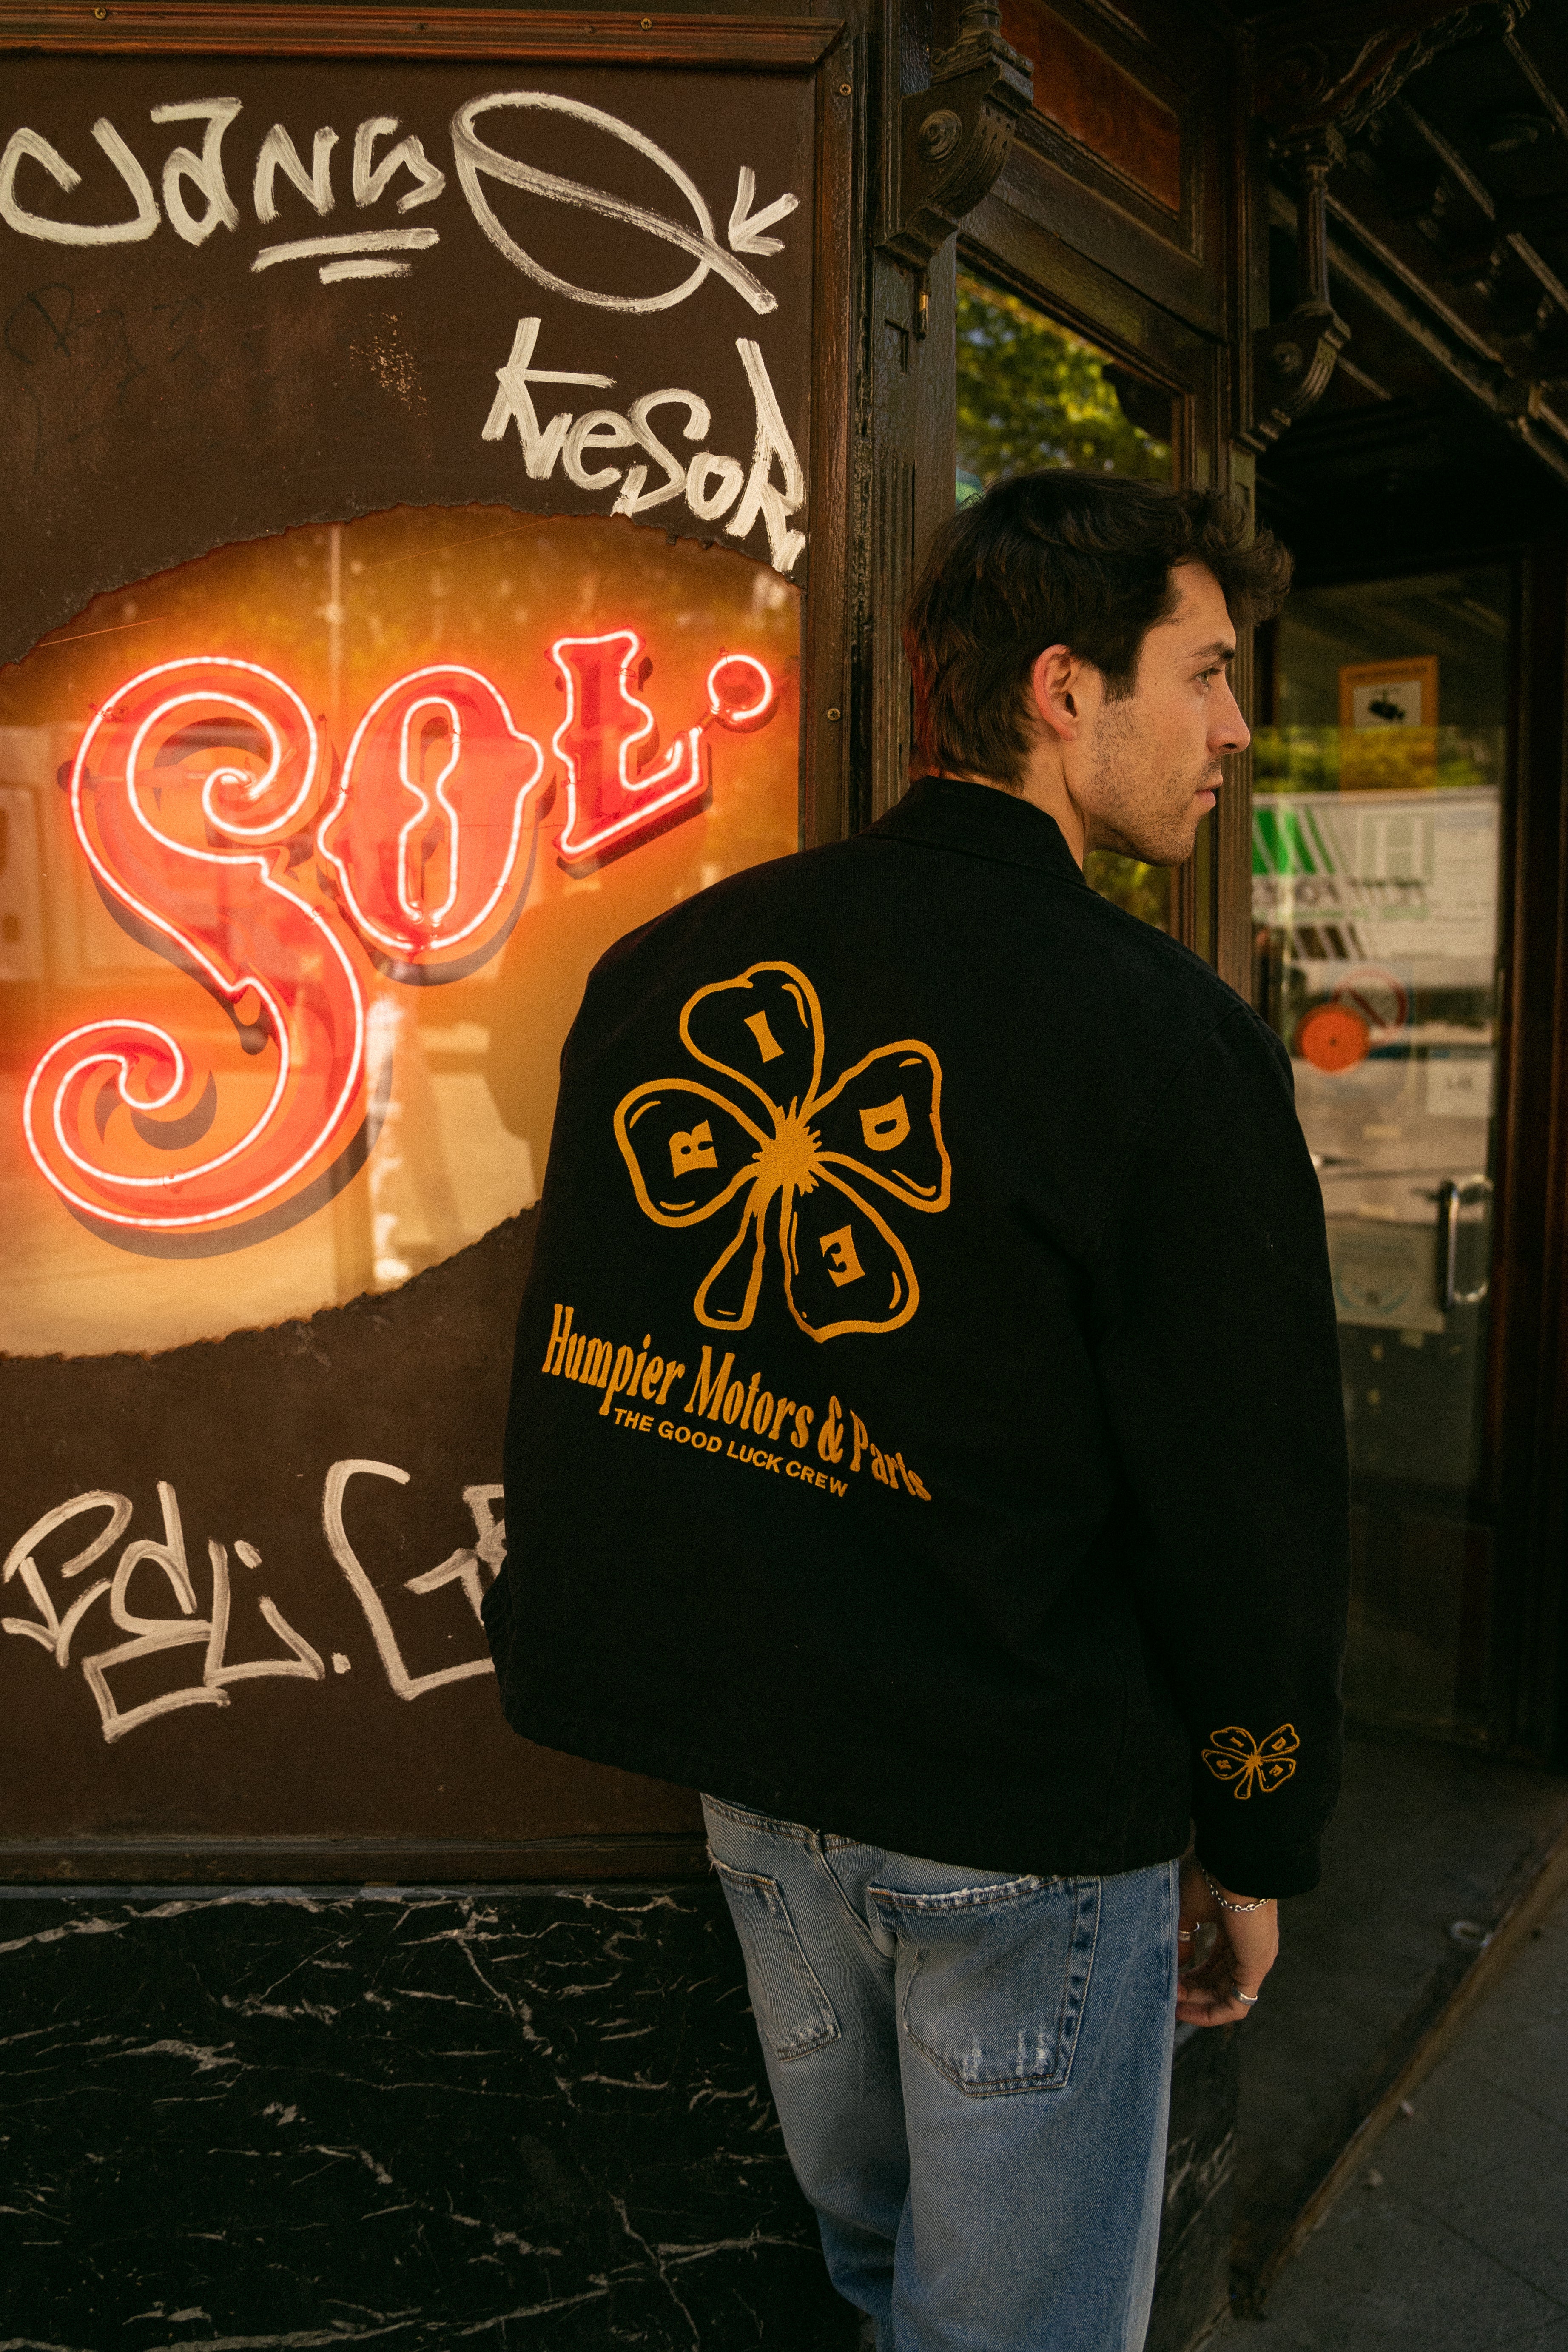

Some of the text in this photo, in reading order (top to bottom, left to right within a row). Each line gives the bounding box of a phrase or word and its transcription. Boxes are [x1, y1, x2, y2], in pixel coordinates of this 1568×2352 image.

[541, 1303, 932, 1501] Humpier Motors & Parts
[614, 1407, 848, 1498] THE GOOD LUCK CREW
